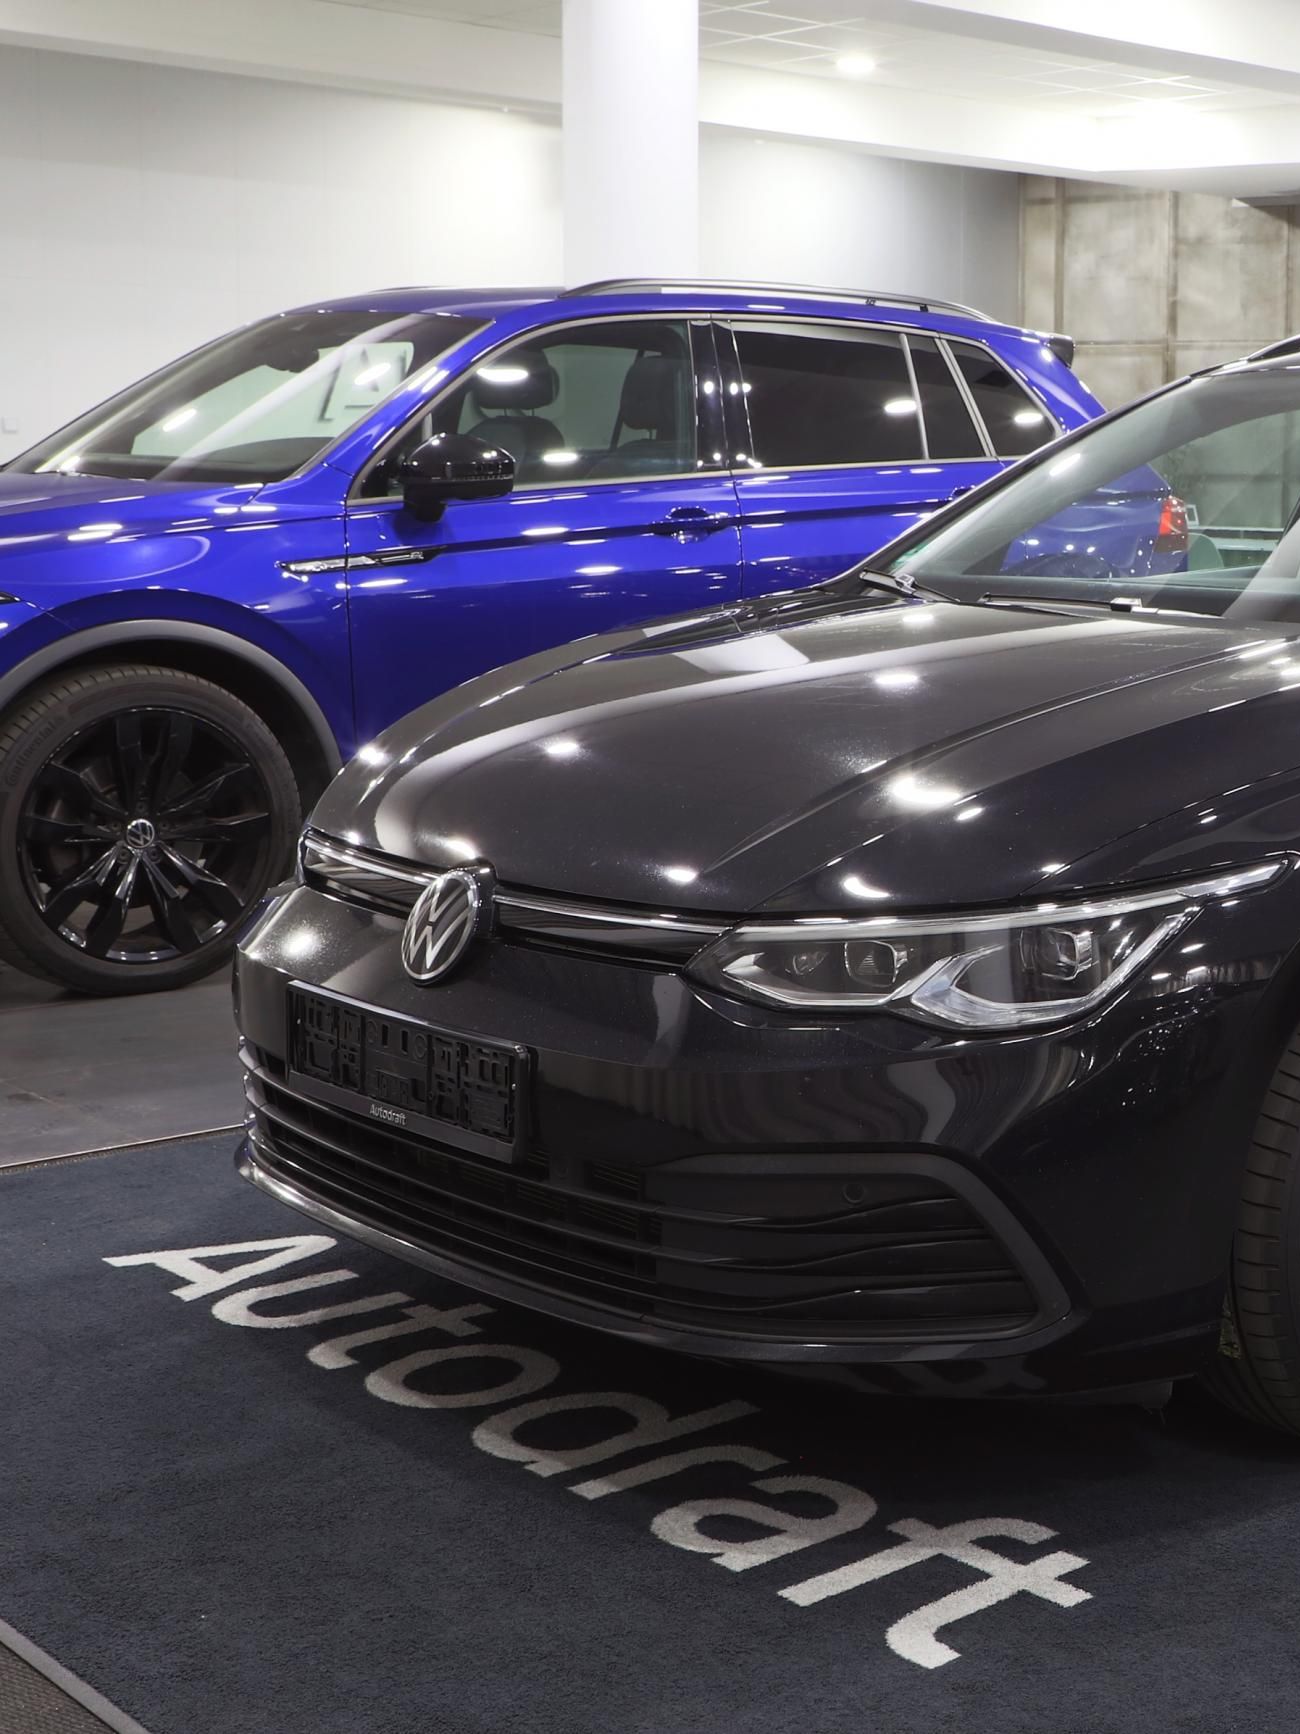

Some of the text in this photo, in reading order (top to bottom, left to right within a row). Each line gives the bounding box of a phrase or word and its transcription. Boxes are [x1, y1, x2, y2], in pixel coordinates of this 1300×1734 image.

[402, 871, 478, 985] VW
[370, 1103, 407, 1126] Autodraft
[102, 1234, 1094, 1669] Autodraft
